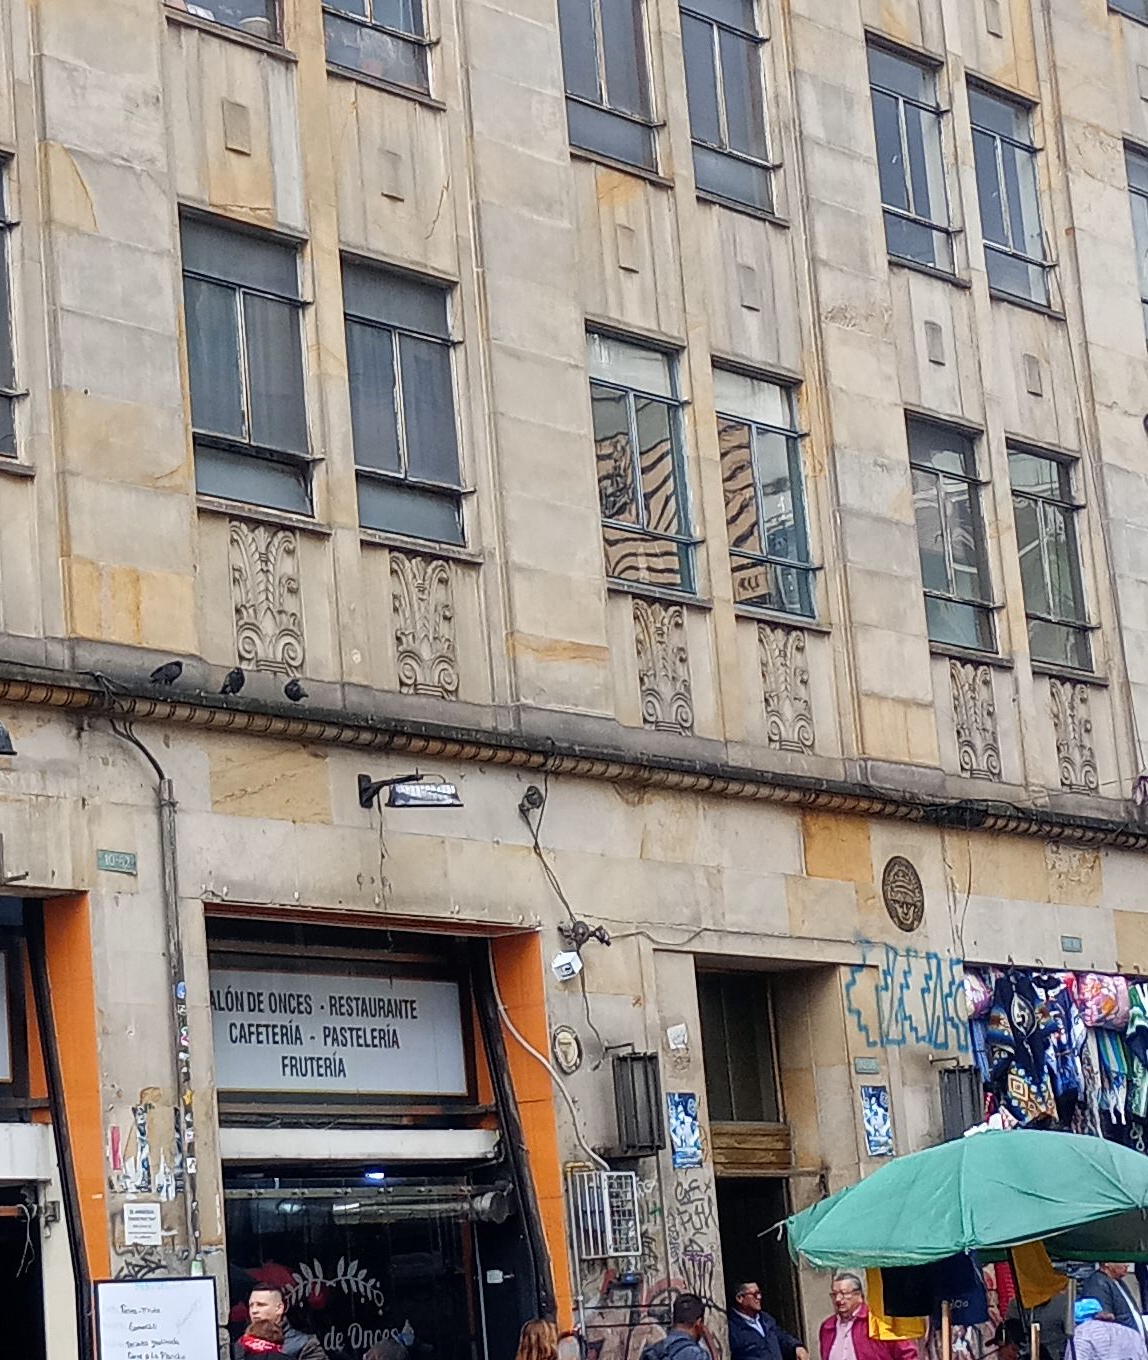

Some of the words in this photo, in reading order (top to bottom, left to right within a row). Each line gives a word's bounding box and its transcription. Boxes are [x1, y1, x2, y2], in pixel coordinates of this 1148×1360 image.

[210, 985, 244, 1012] ALÓN
[249, 991, 264, 1013] DE
[269, 992, 313, 1015] ONCES
[329, 995, 418, 1020] RESTAURANTE
[229, 1018, 303, 1045] CAFETERÍA
[323, 1023, 400, 1049] PASTELERÍA
[281, 1051, 347, 1078] FRUTERÍA
[324, 1326, 343, 1351] de
